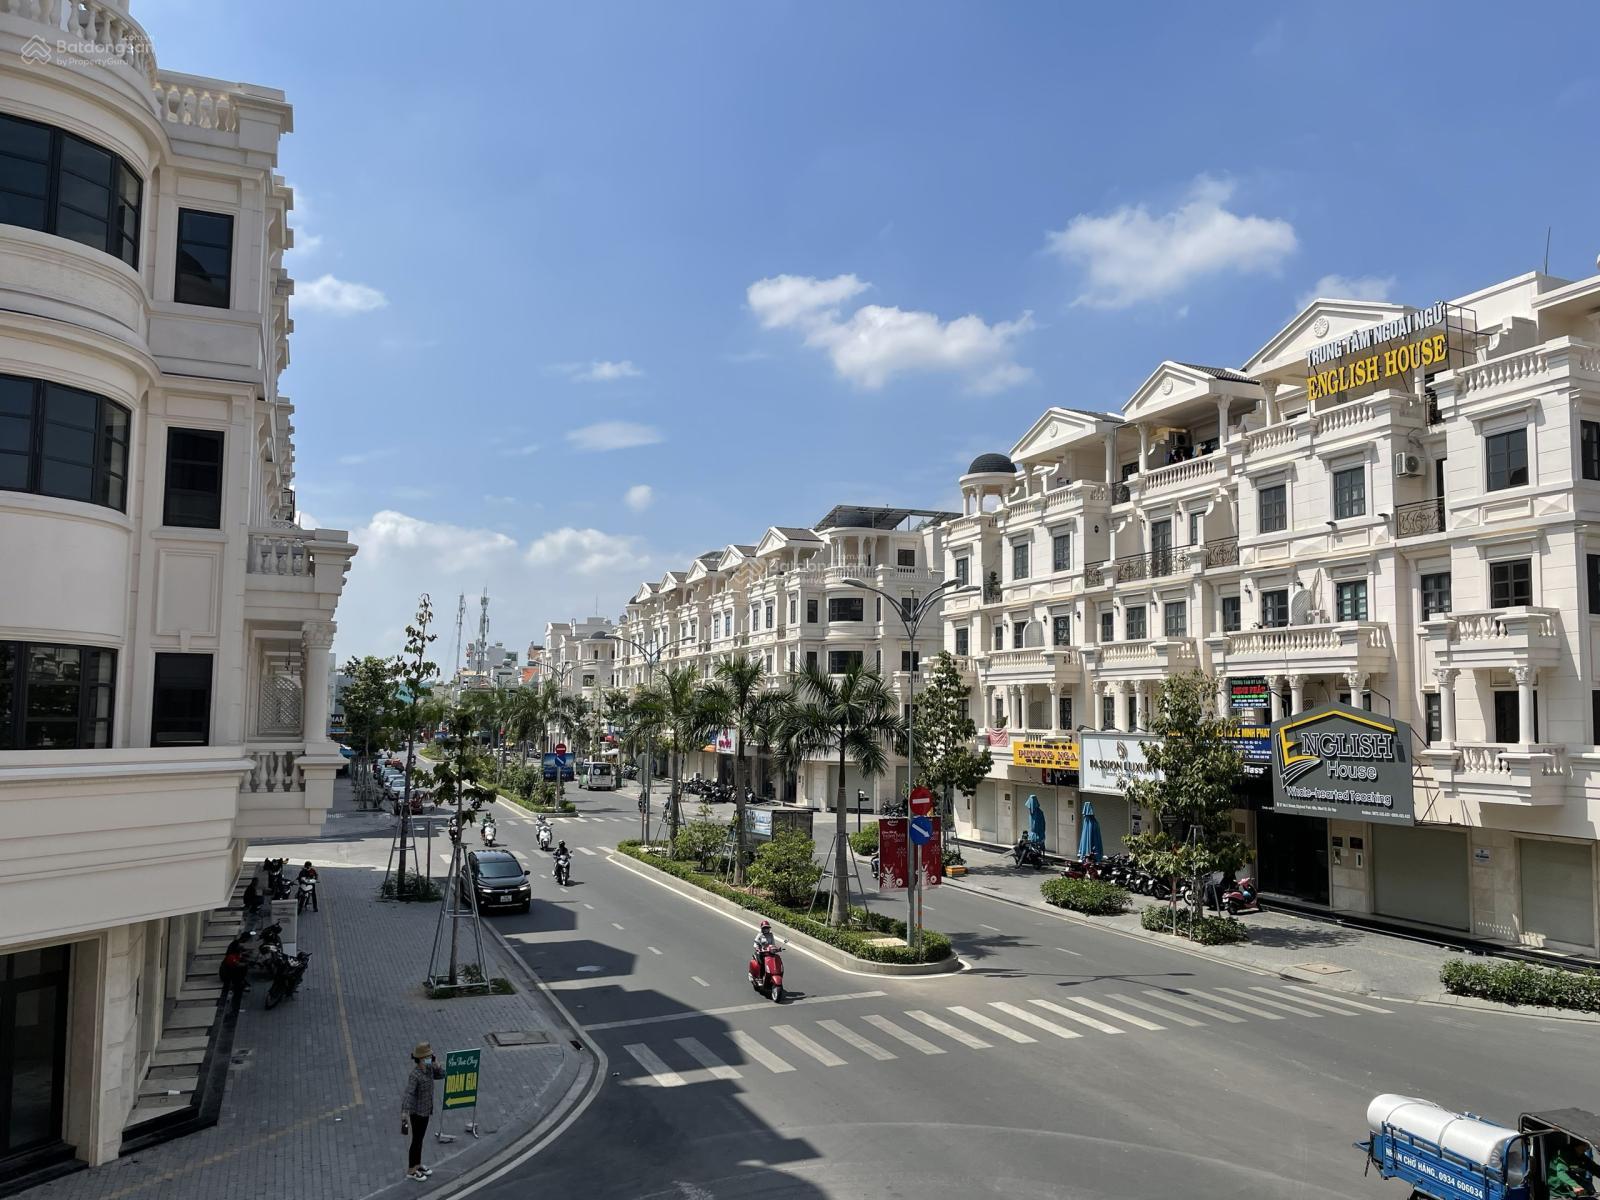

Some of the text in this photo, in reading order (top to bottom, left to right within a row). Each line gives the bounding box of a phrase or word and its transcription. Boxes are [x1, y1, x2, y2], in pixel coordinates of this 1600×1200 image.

[1306, 301, 1446, 367] TRUNG TÂM NGOẠI NGỮ
[1307, 335, 1446, 400] ENGLISH HOUSE
[1090, 759, 1122, 772] PASSION
[1326, 761, 1377, 779] House
[1286, 785, 1392, 806] Whole-hearted Teaching
[1438, 1171, 1455, 1186] 0934
[1457, 1180, 1483, 1199] 606034
